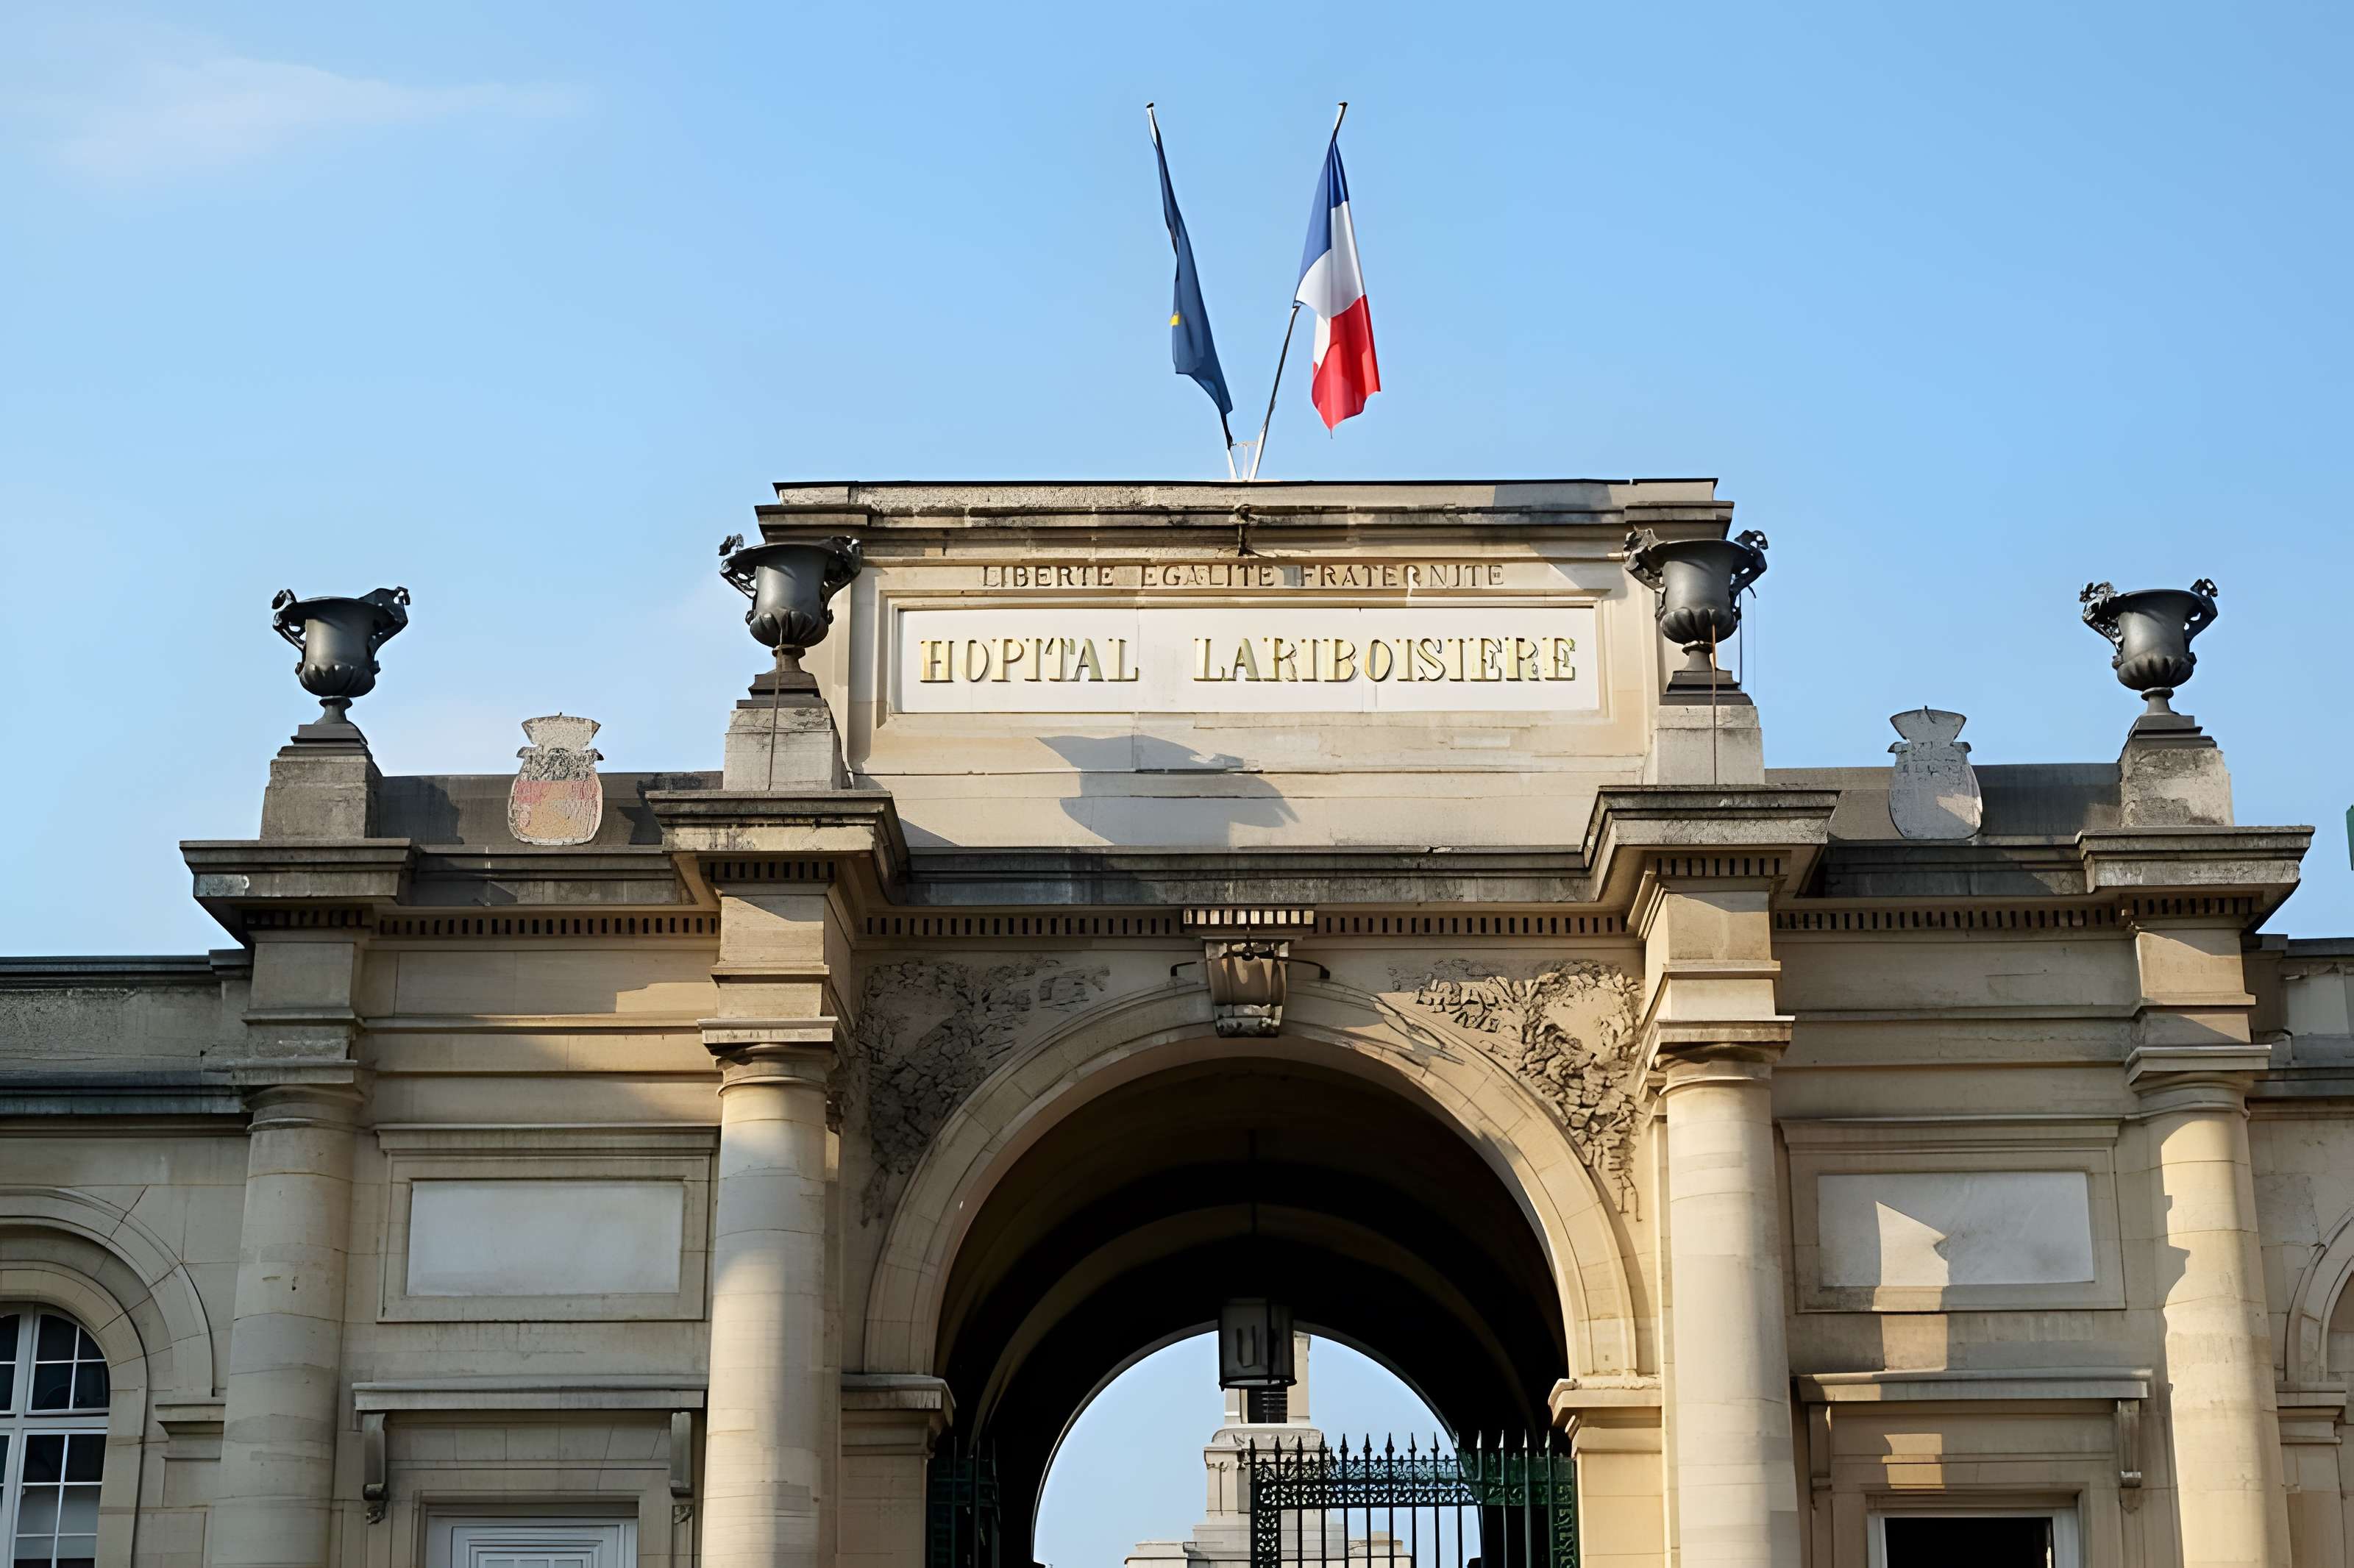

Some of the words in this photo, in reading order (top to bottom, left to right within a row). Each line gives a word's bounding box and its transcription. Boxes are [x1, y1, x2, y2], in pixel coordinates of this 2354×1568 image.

[982, 565, 1114, 587] LIBERTE
[1141, 564, 1274, 587] EGALITE
[1300, 564, 1504, 587] FRATERNITE
[920, 637, 1139, 683] HOPITAL
[1193, 636, 1576, 683] LARIBOISIERE
